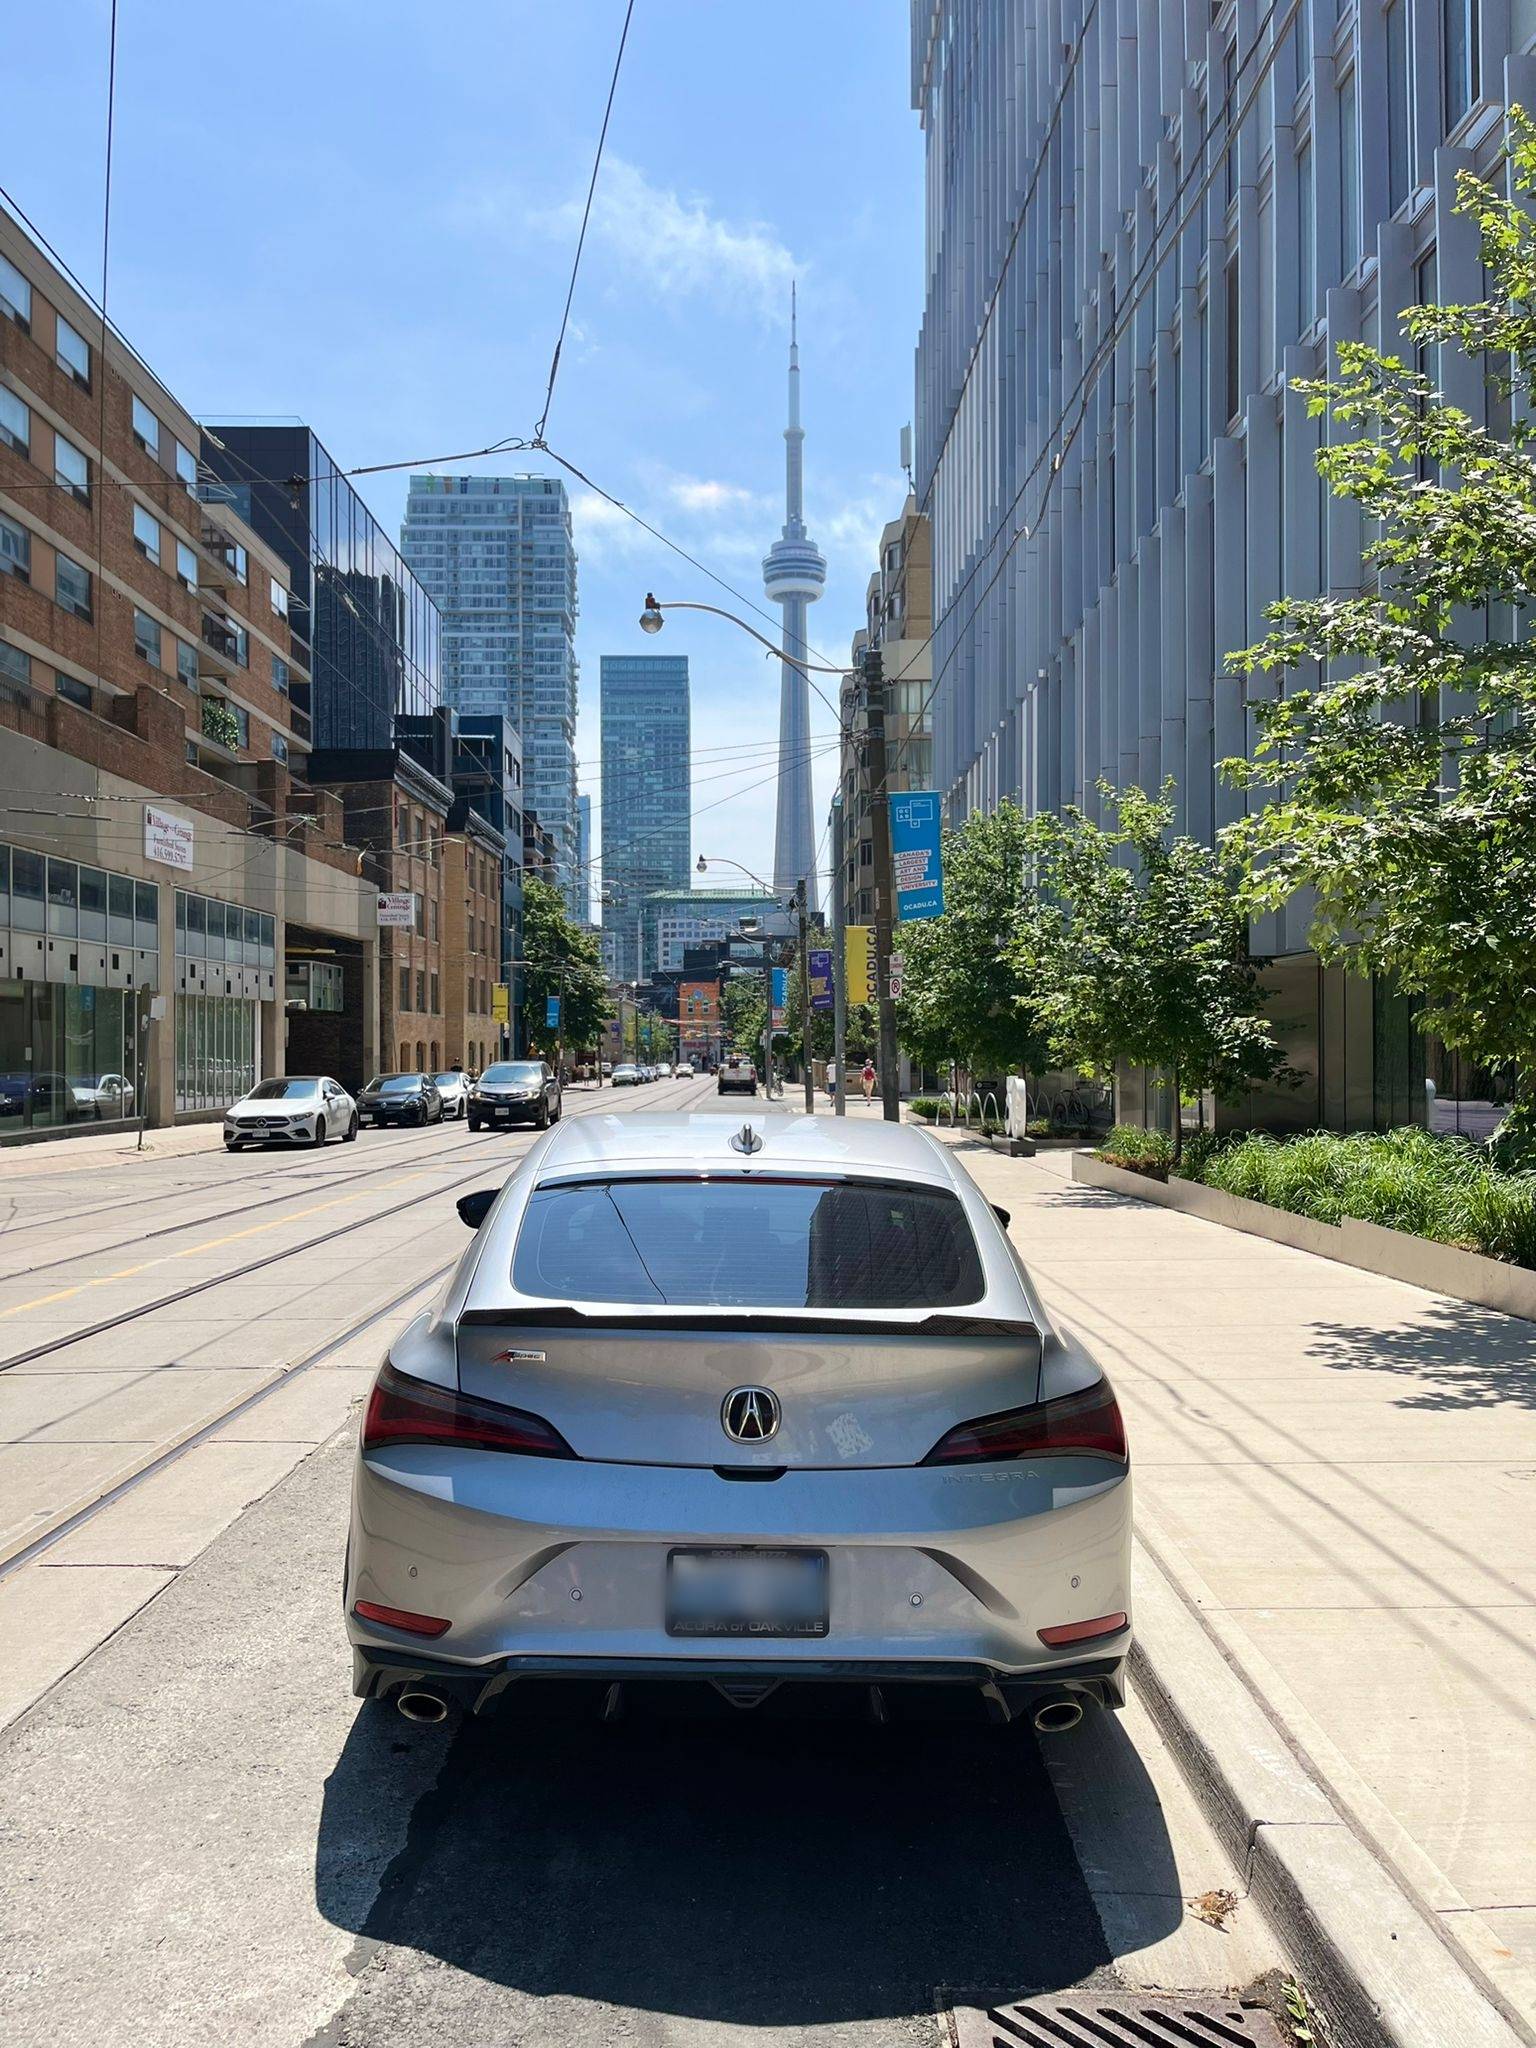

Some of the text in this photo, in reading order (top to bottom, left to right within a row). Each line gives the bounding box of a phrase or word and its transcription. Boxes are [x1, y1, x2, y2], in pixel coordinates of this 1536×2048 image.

[898, 850, 930, 860] CANADA'S
[899, 858, 927, 868] LARGEST
[900, 865, 927, 875] ART AND
[900, 874, 922, 883] DESIGN
[900, 880, 937, 891] UNIVERSITY
[903, 900, 938, 911] OCADU.CA
[866, 927, 877, 1004] OCADU.CA
[942, 1470, 1040, 1483] INTEGRA
[672, 1622, 728, 1632] ACURA
